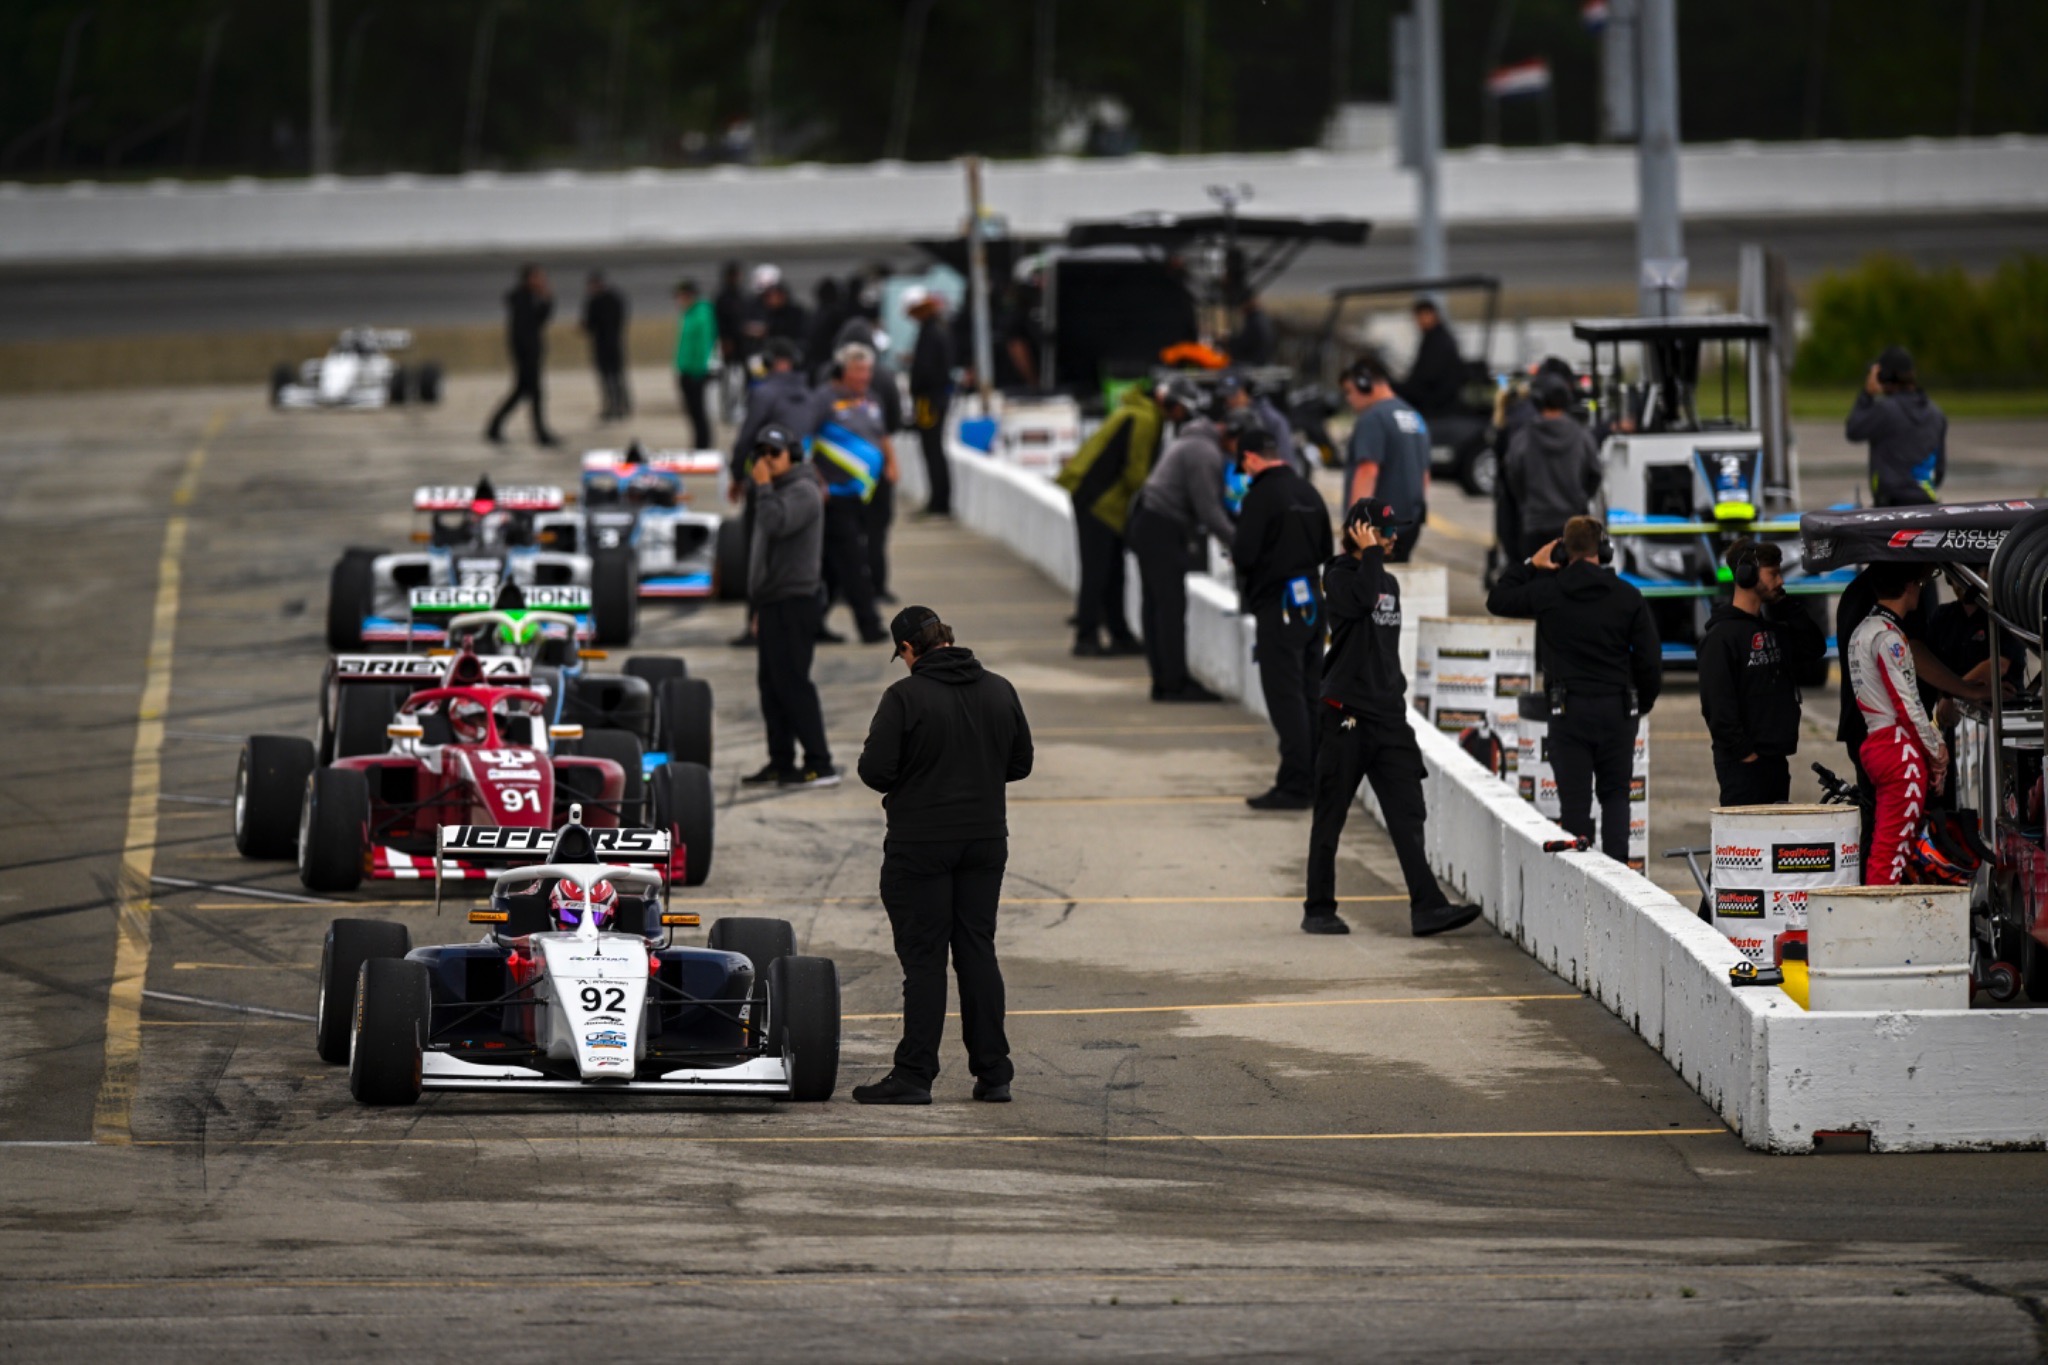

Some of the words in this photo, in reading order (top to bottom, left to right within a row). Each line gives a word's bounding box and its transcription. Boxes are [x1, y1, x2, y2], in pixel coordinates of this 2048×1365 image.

[501, 789, 541, 813] 91
[446, 826, 655, 850] JEFFRS
[580, 987, 626, 1013] 92
